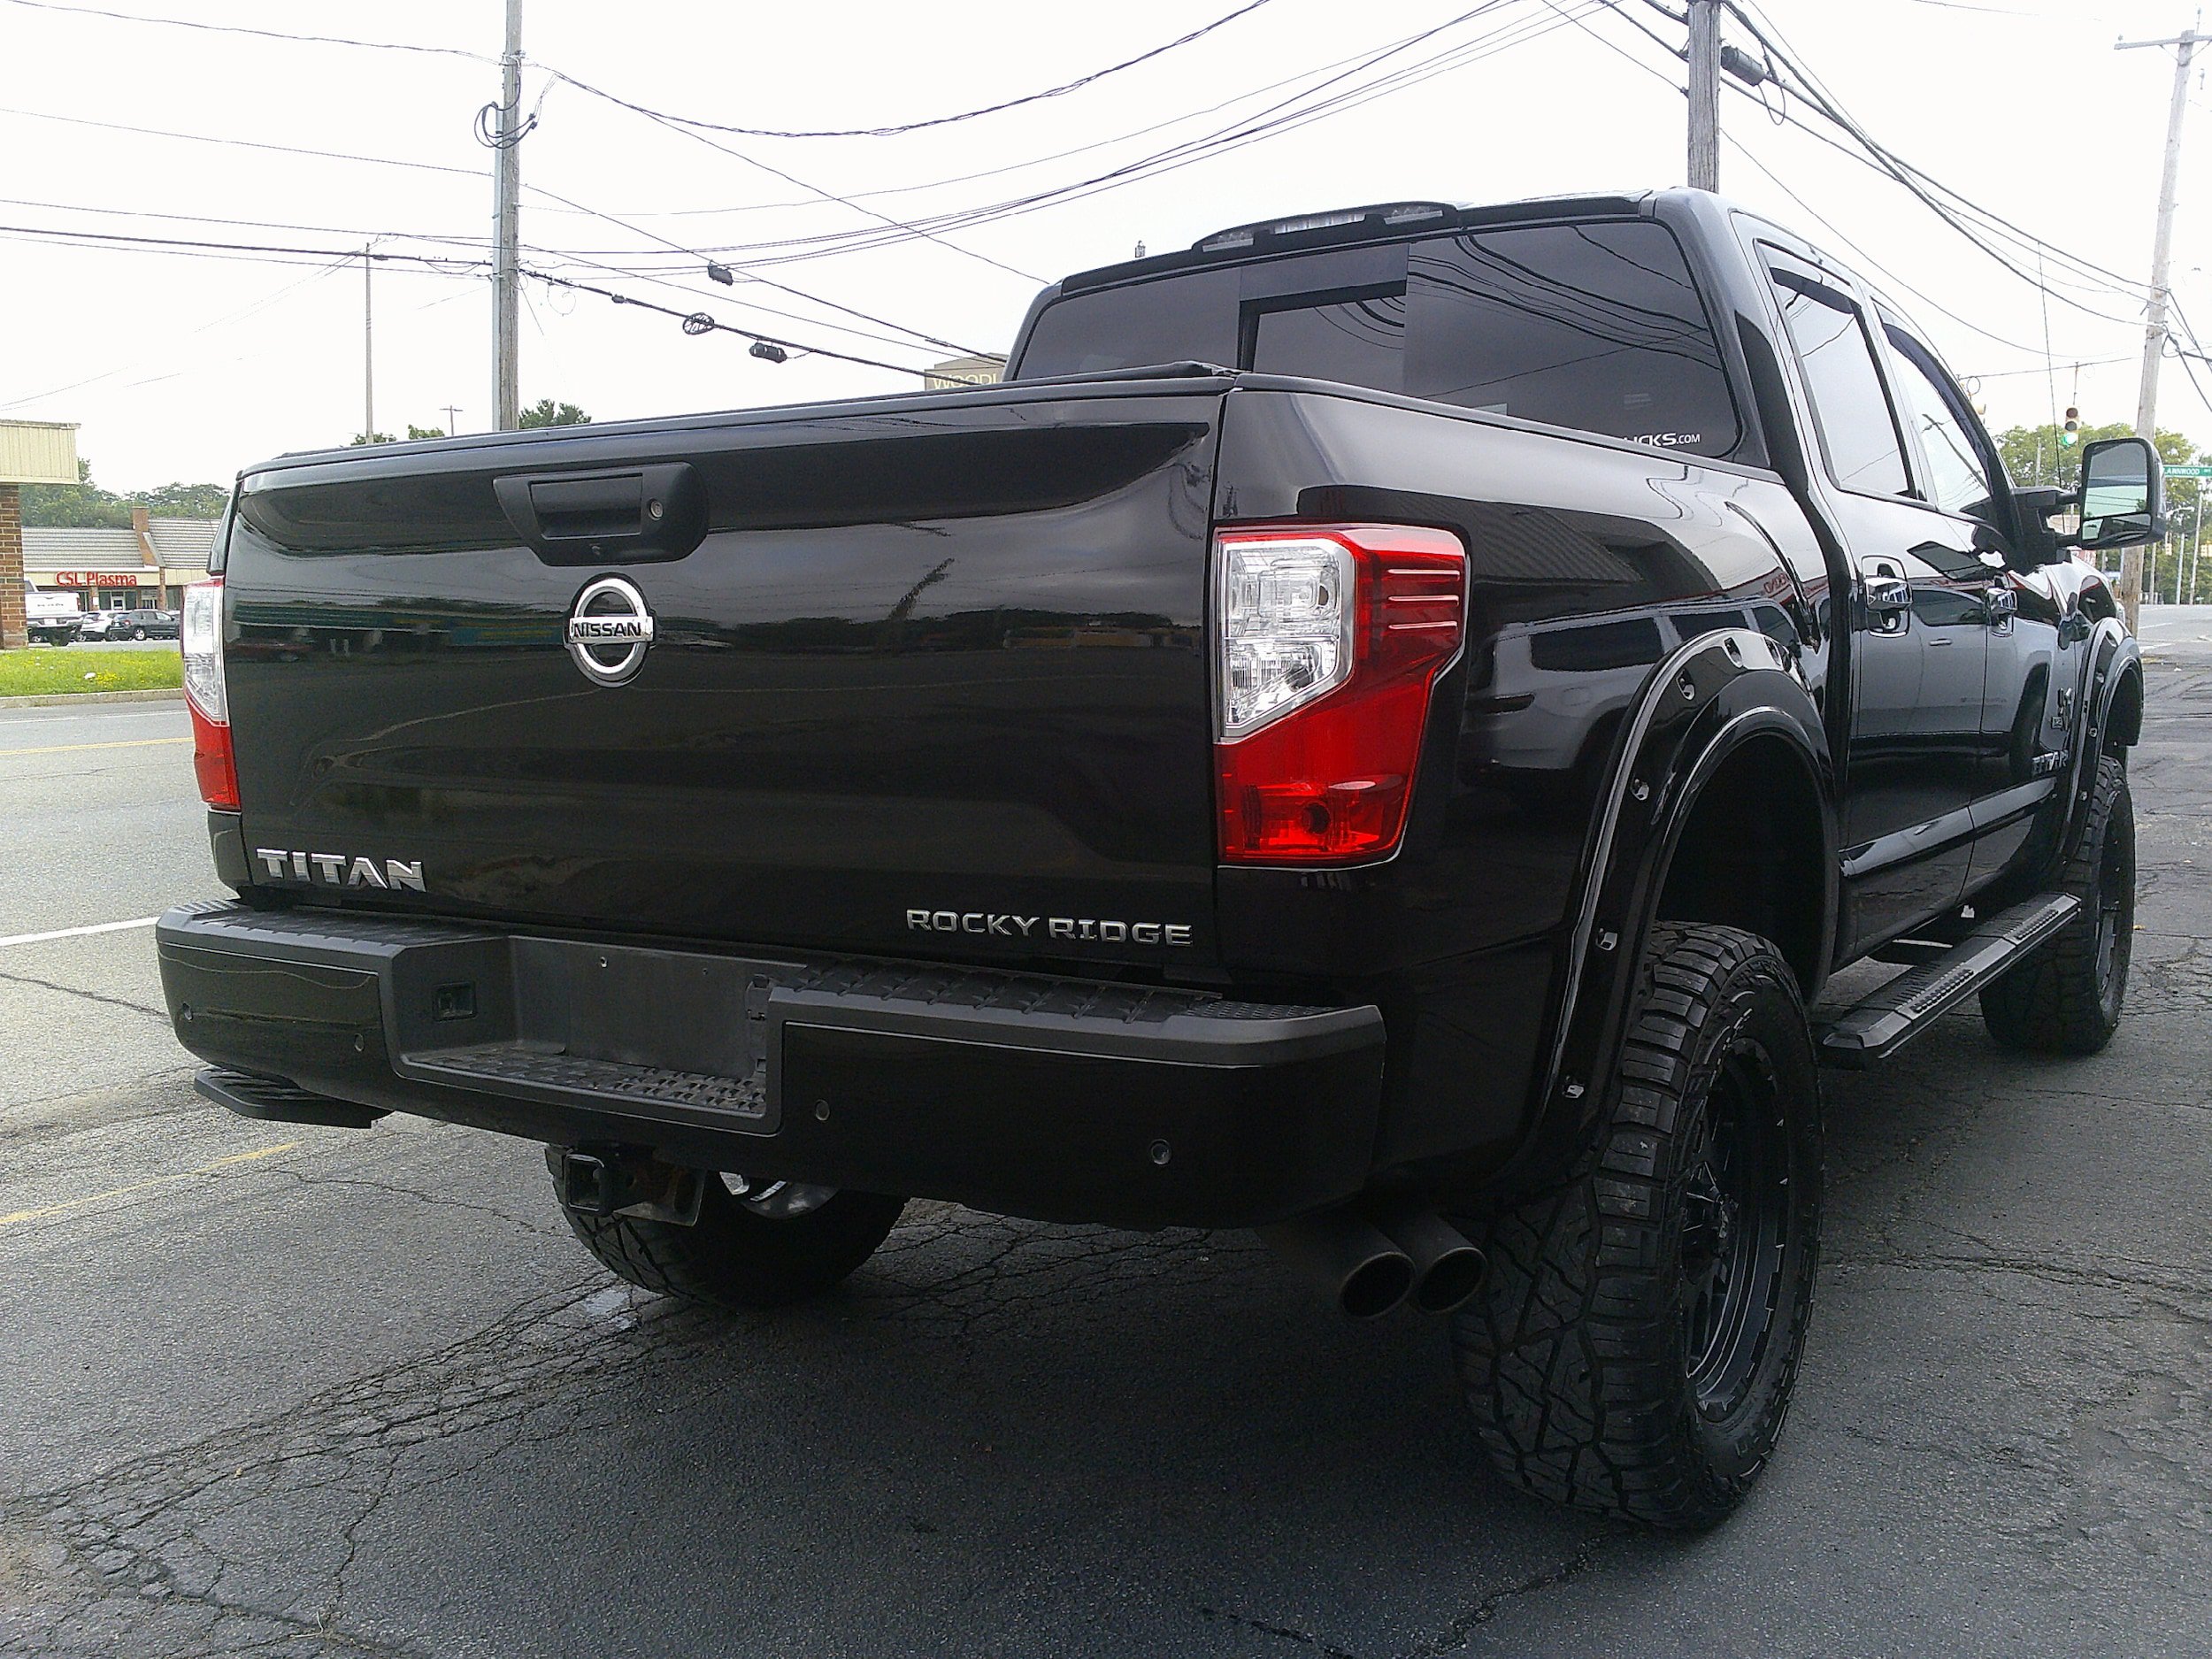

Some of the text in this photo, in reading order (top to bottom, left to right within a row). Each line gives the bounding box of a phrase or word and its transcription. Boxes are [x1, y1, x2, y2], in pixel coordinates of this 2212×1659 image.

[1624, 432, 1701, 446] CKS.COM
[56, 571, 137, 587] CSL Plasma
[572, 622, 641, 637] NISSAN
[257, 848, 426, 893] TITAN
[906, 909, 1193, 946] ROCKY RIDGE
